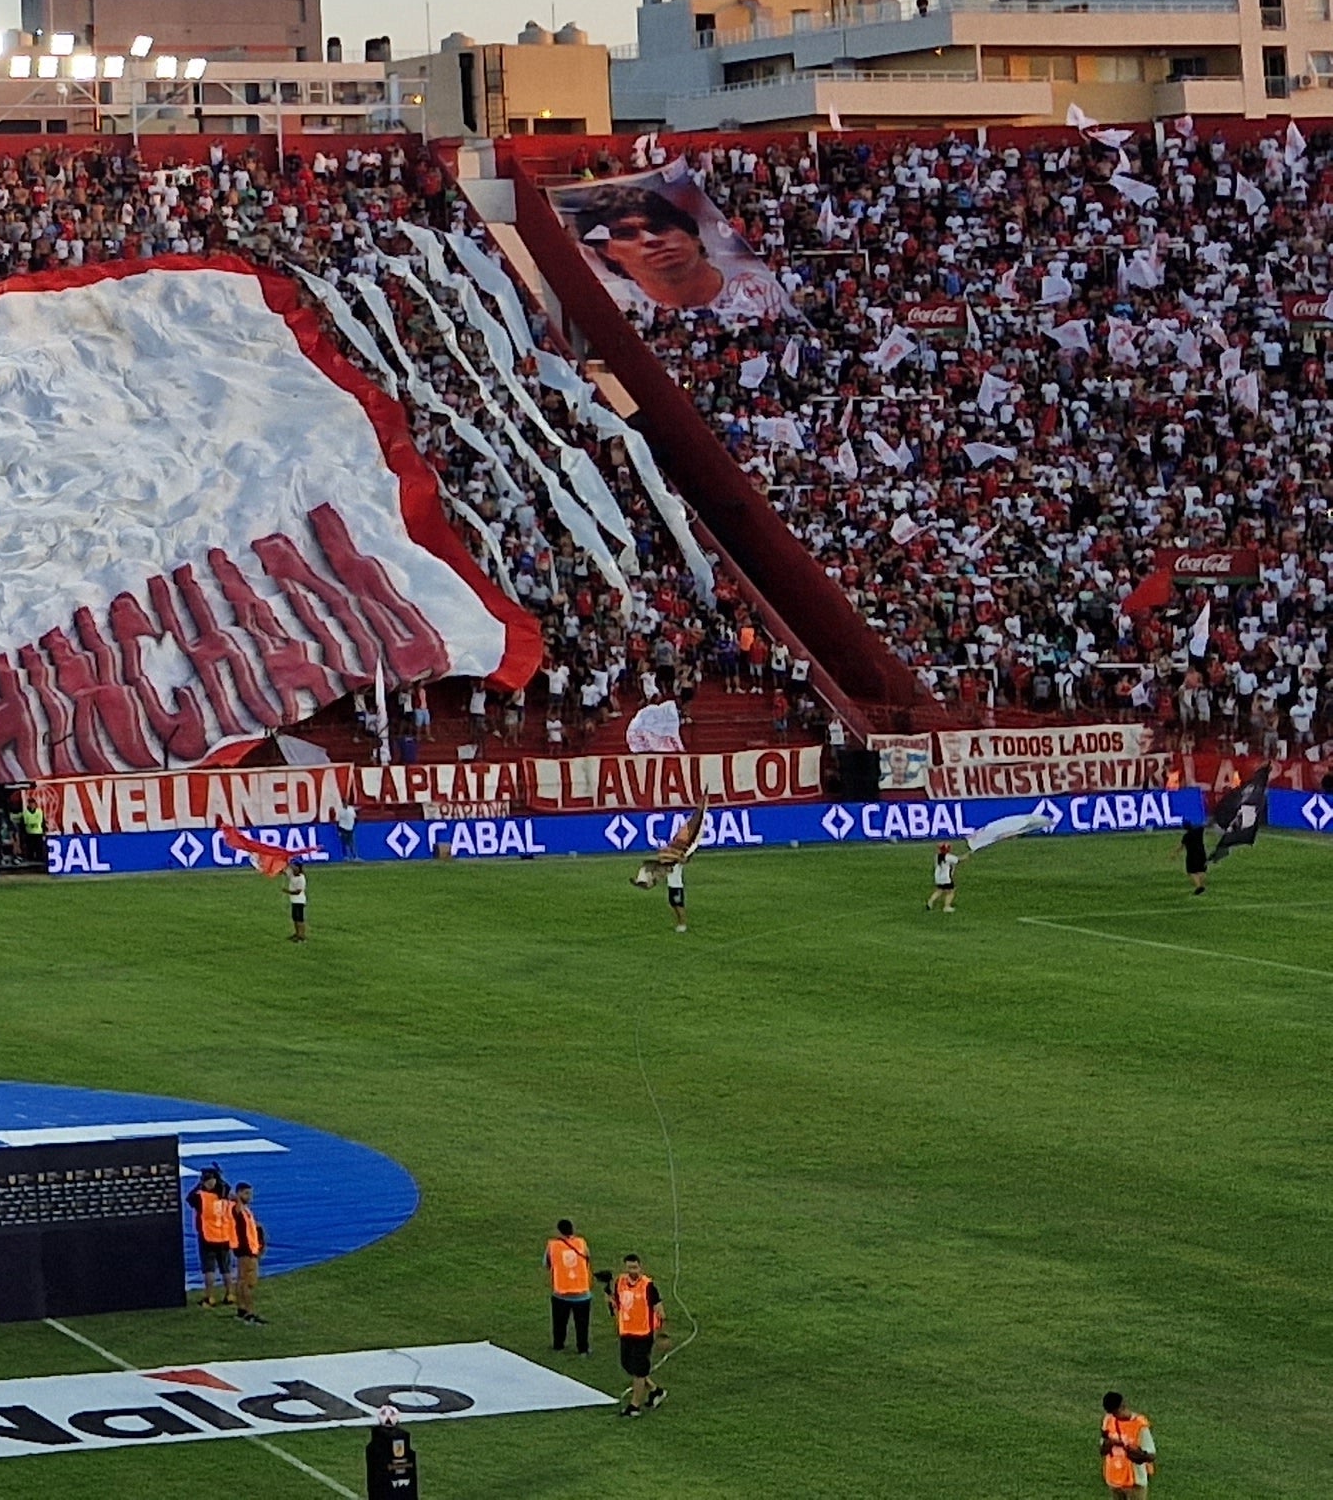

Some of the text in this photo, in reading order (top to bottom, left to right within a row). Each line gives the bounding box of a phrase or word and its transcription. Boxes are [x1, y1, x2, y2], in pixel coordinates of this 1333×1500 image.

[969, 730, 1124, 758] A TODOS LADOS
[61, 768, 346, 834] AVELLANEDA
[1069, 791, 1183, 830] CABAL
[862, 802, 975, 838] CABAL
